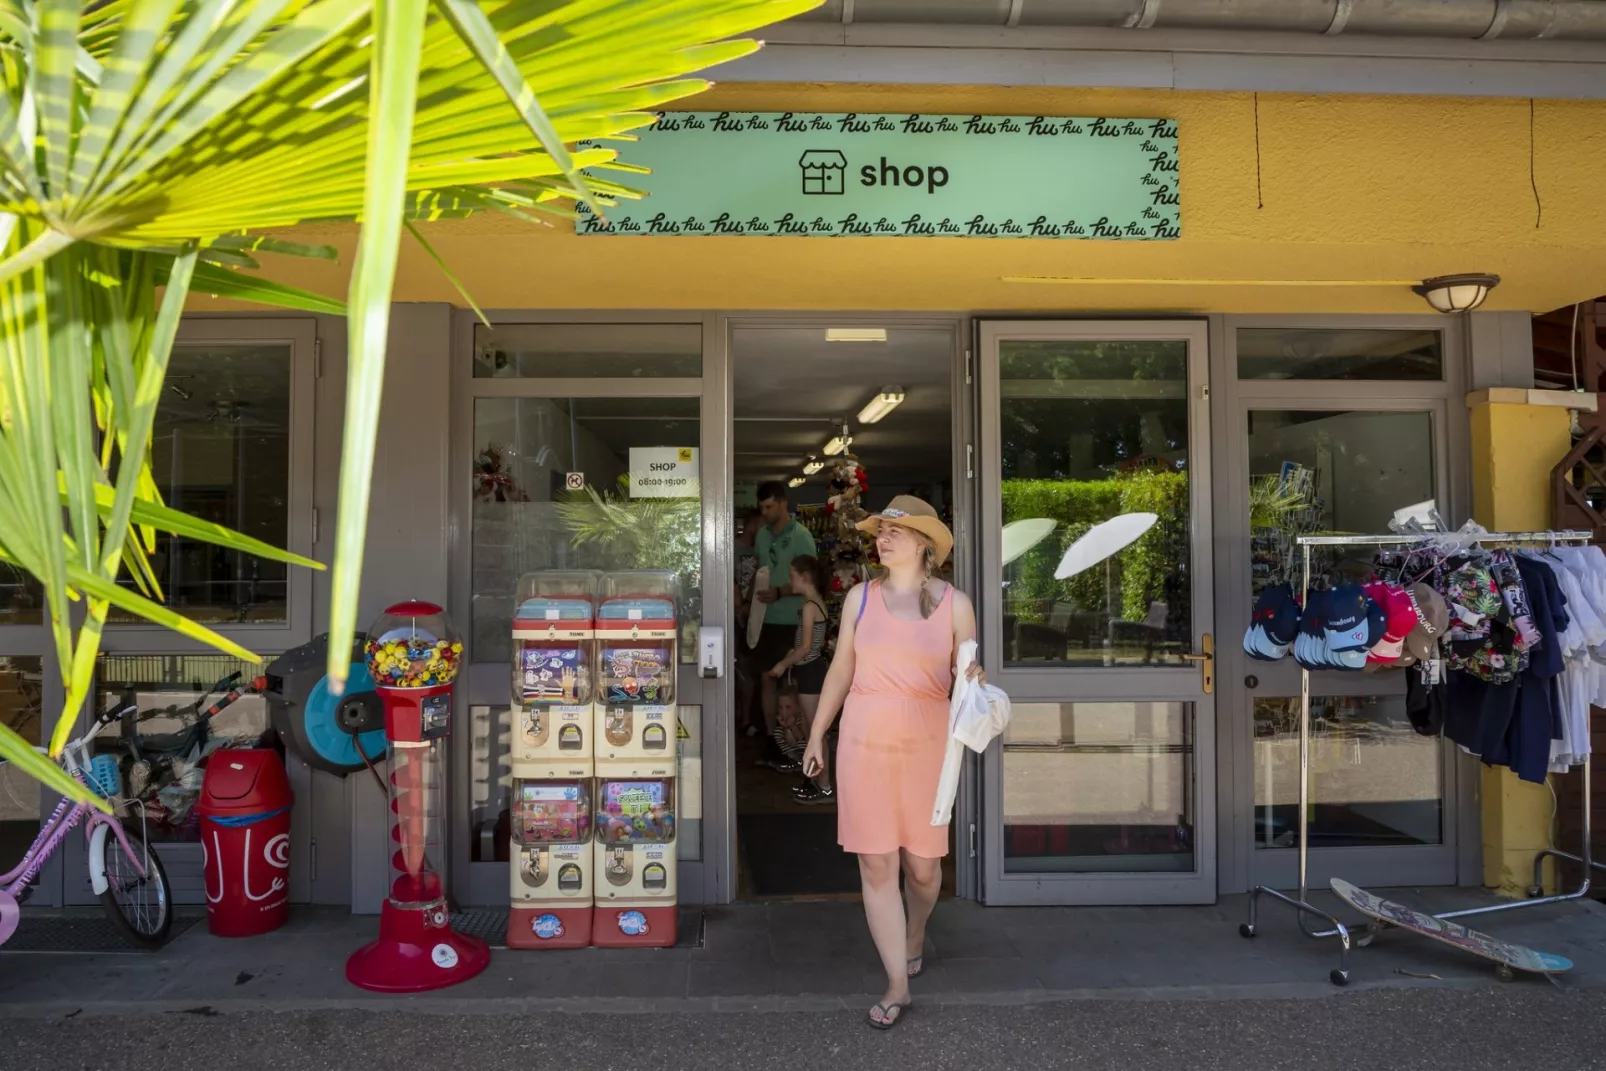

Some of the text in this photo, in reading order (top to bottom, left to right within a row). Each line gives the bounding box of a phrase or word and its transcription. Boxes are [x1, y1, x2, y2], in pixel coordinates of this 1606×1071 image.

[649, 110, 1179, 139] hu hu hu hu hu hu hu hu hu hu hu hu hu hu hu hu hu
[1139, 139, 1159, 152] hu
[1149, 151, 1180, 172] hu
[860, 156, 949, 194] shop
[1140, 173, 1160, 186] hu
[1149, 184, 1181, 205] hu
[1141, 206, 1161, 219] hu
[581, 212, 1181, 239] hu hu hu hu hu hu hu hu hu hu hu hu hu hu hu hu hu hu hu
[649, 462, 677, 472] SHOP
[638, 478, 687, 487] 08:00-19:00
